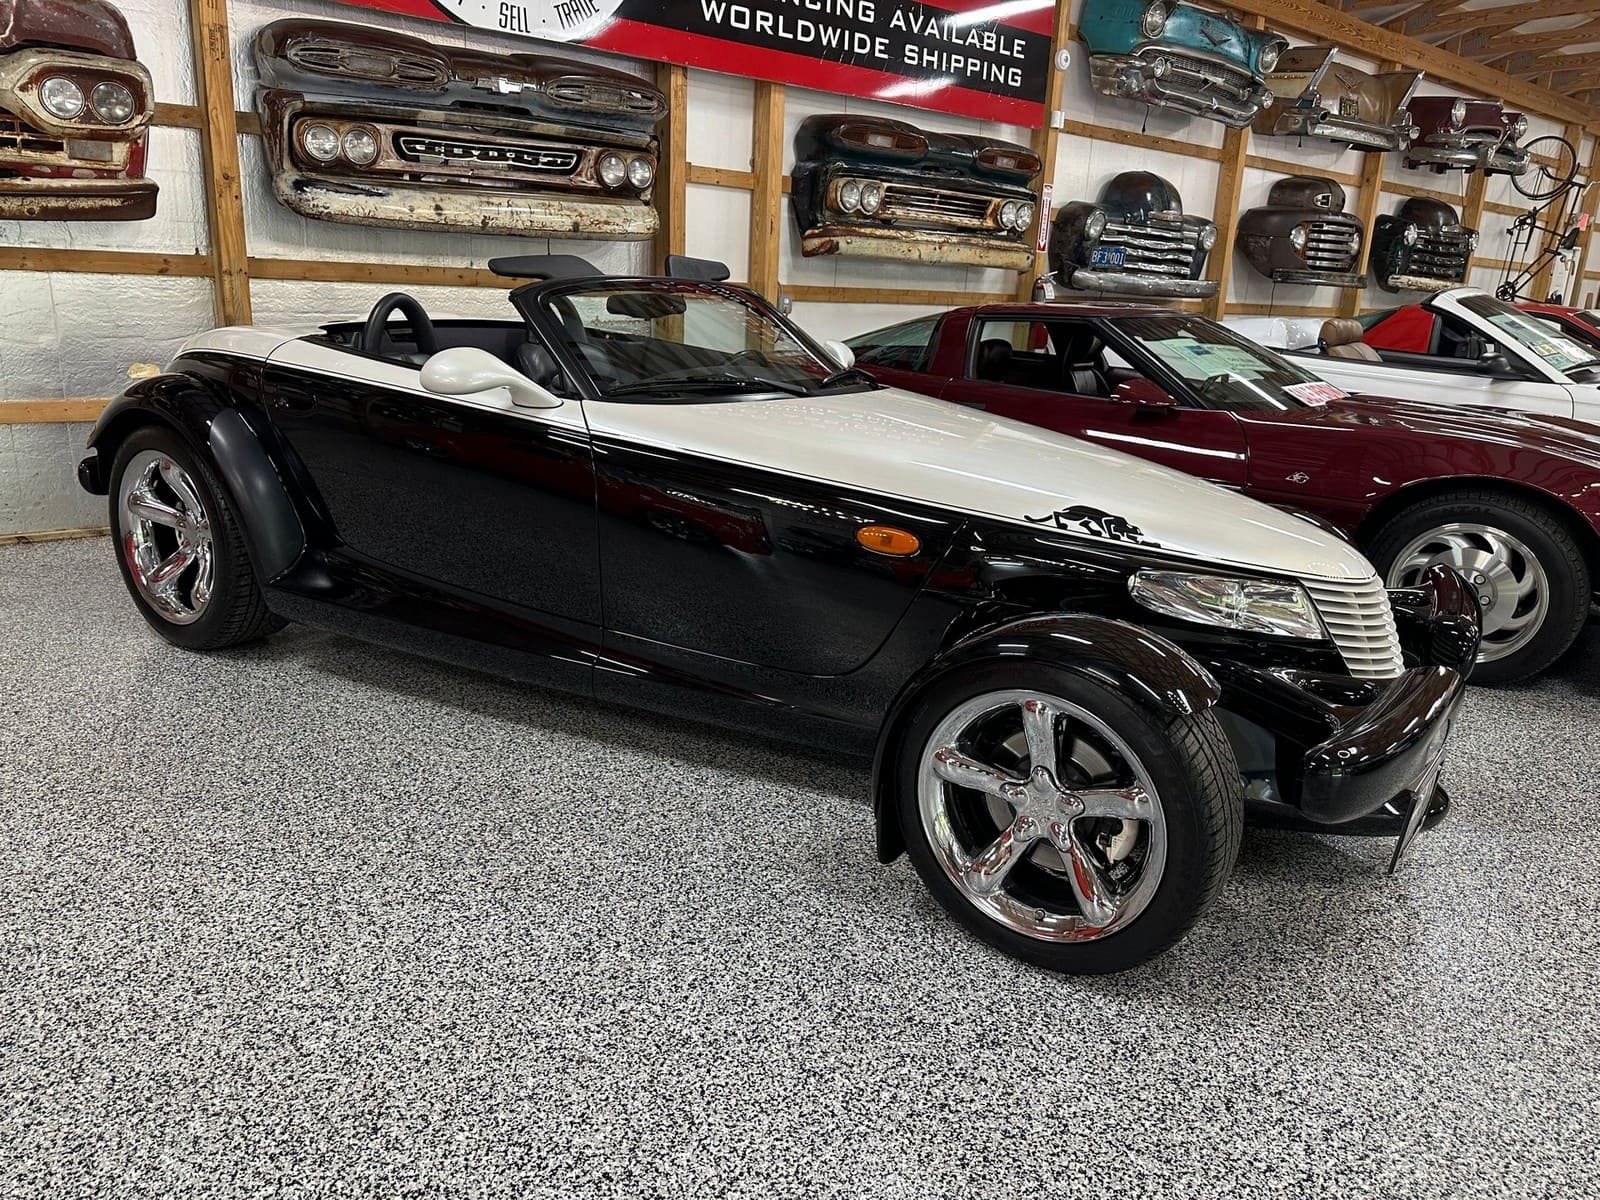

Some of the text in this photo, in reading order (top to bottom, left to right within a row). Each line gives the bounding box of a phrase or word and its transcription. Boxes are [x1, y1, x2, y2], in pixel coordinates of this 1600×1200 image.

[499, 2, 531, 33] SELL
[889, 9, 1026, 59] AVAILABLE
[701, 0, 1022, 87] WORLDWIDE SHIPPING
